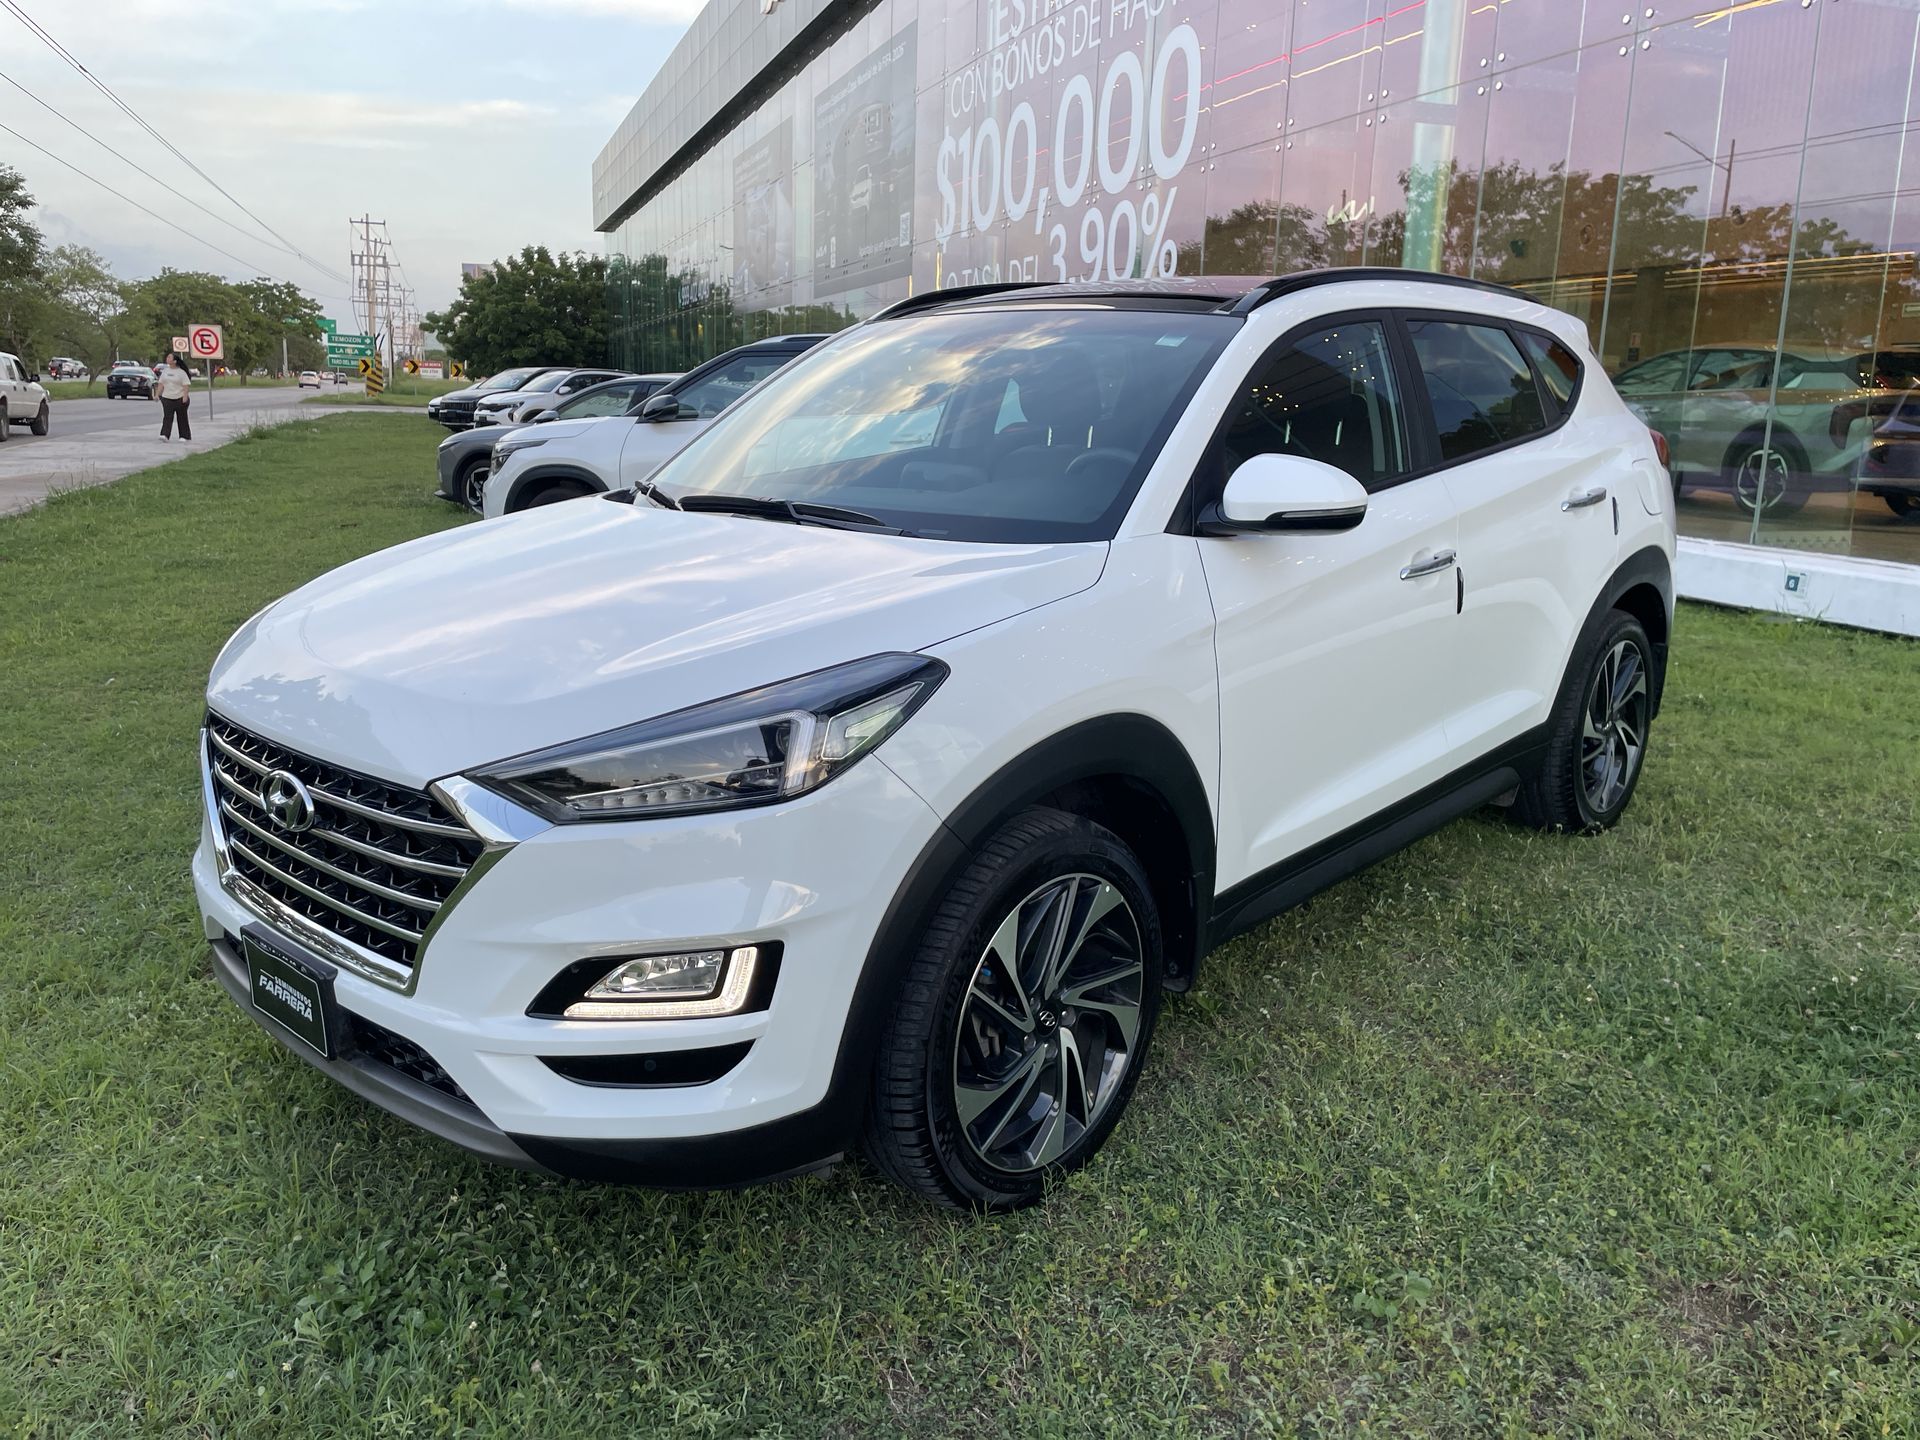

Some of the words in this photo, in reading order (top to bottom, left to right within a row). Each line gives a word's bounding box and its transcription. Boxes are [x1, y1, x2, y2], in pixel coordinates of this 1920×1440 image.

[951, 60, 987, 118] CON
[991, 15, 1066, 98] BONOS
[1071, 0, 1101, 58] DE
[936, 24, 1201, 253] $100,000
[1051, 187, 1177, 284] 3.90%
[259, 974, 313, 1022] FARRERA
